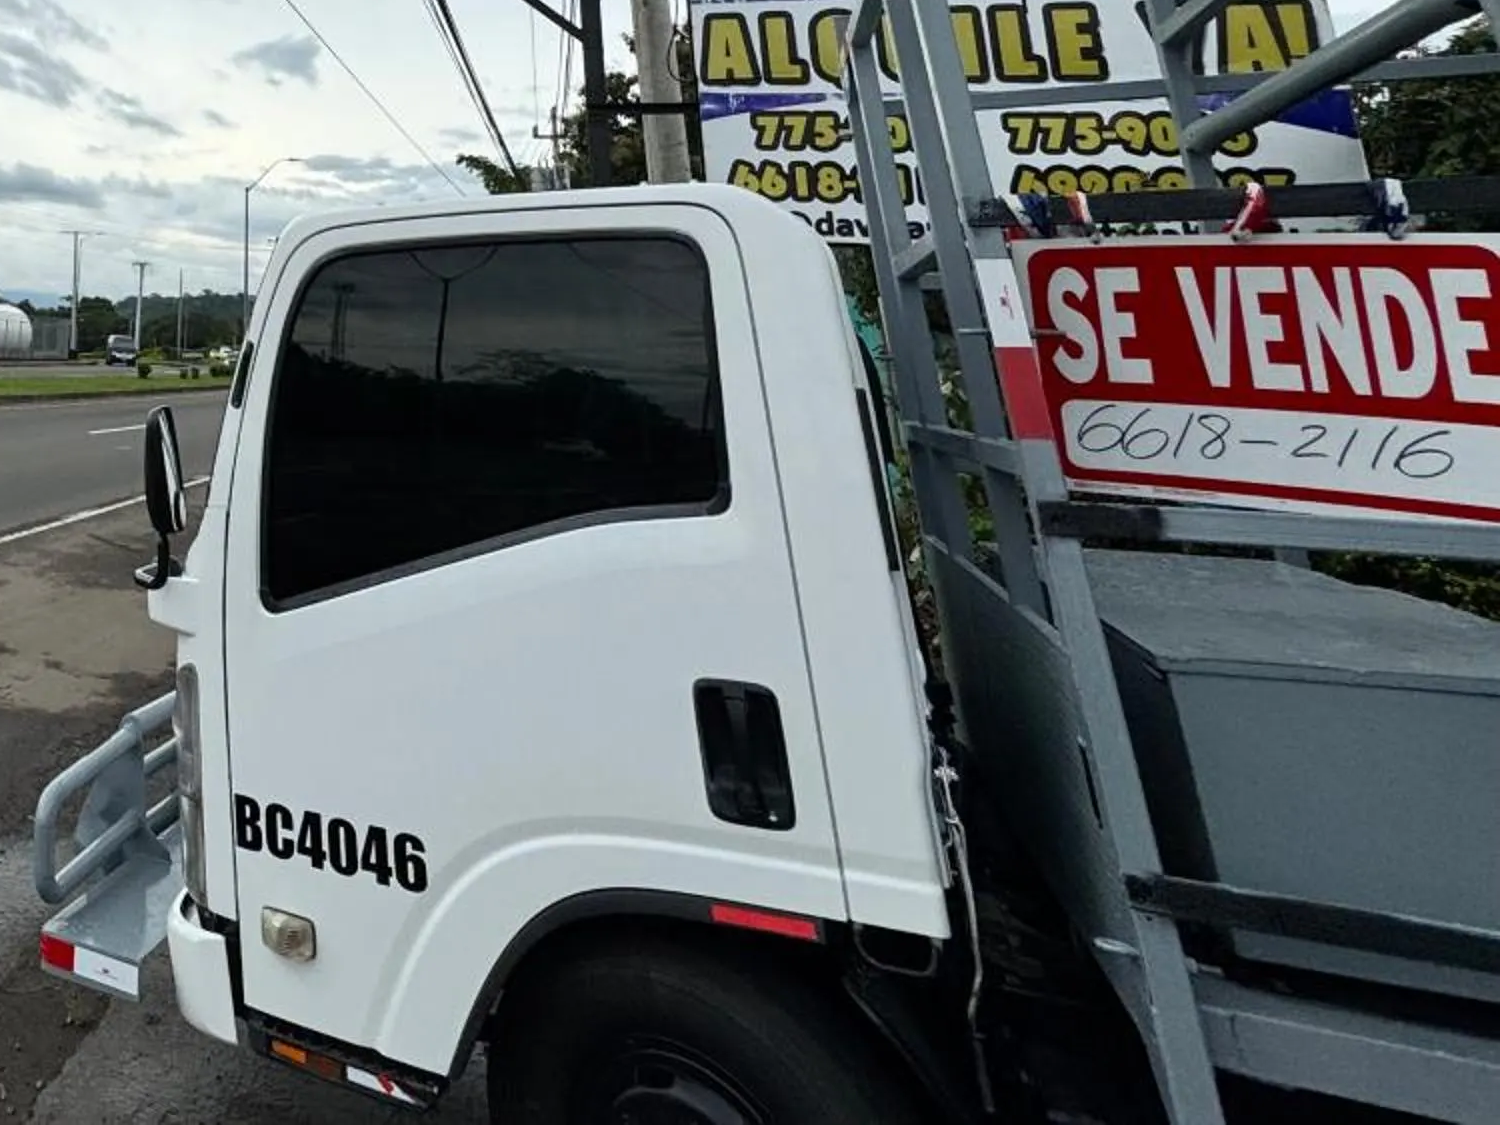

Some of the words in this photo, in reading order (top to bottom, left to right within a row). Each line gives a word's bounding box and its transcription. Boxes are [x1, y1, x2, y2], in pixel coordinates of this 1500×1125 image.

[1047, 266, 1154, 384] SE
[1174, 266, 1500, 404] VENDE
[1077, 403, 1454, 478] 6618-2116
[234, 793, 428, 892] BC4046
